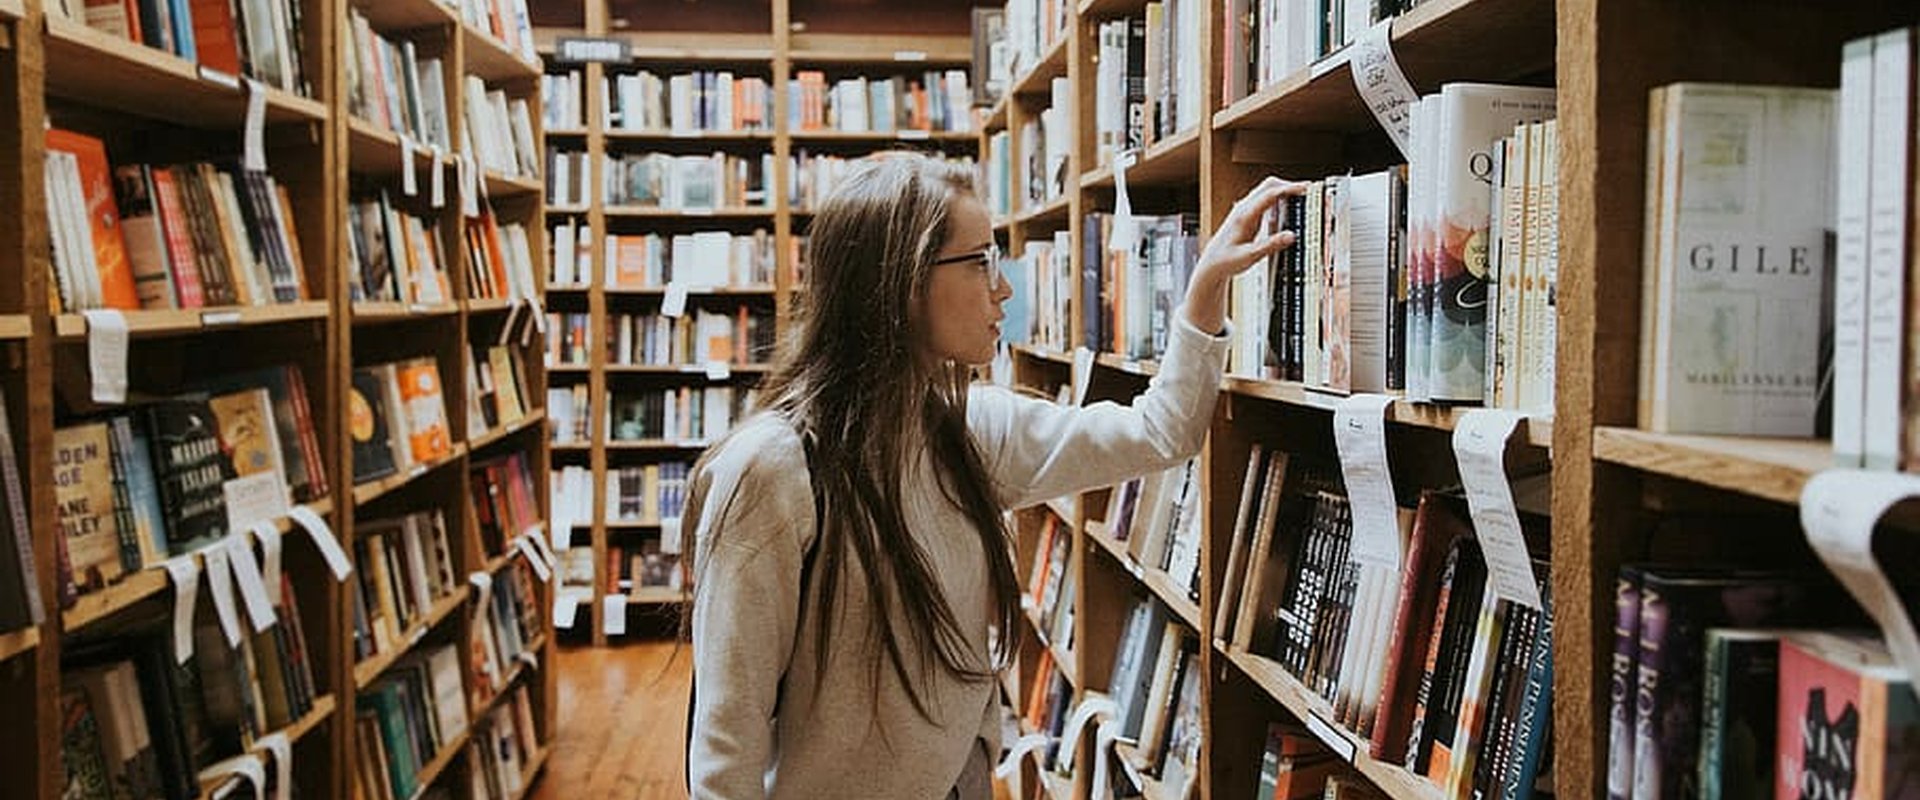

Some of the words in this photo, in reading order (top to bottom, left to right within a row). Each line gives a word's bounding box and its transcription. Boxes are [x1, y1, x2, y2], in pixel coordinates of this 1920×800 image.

[1469, 152, 1494, 185] Q
[1689, 244, 1811, 275] GILE
[1794, 374, 1817, 387] RO
[55, 442, 98, 466] DEN
[56, 467, 83, 488] GE
[58, 497, 89, 517] ANE
[65, 513, 101, 537] ILEY
[1612, 653, 1630, 728] ROS
[1636, 663, 1658, 745] ROS
[1505, 680, 1541, 800] PUNISHMENT
[1800, 714, 1851, 771] NIN
[1781, 754, 1847, 800] WOM
